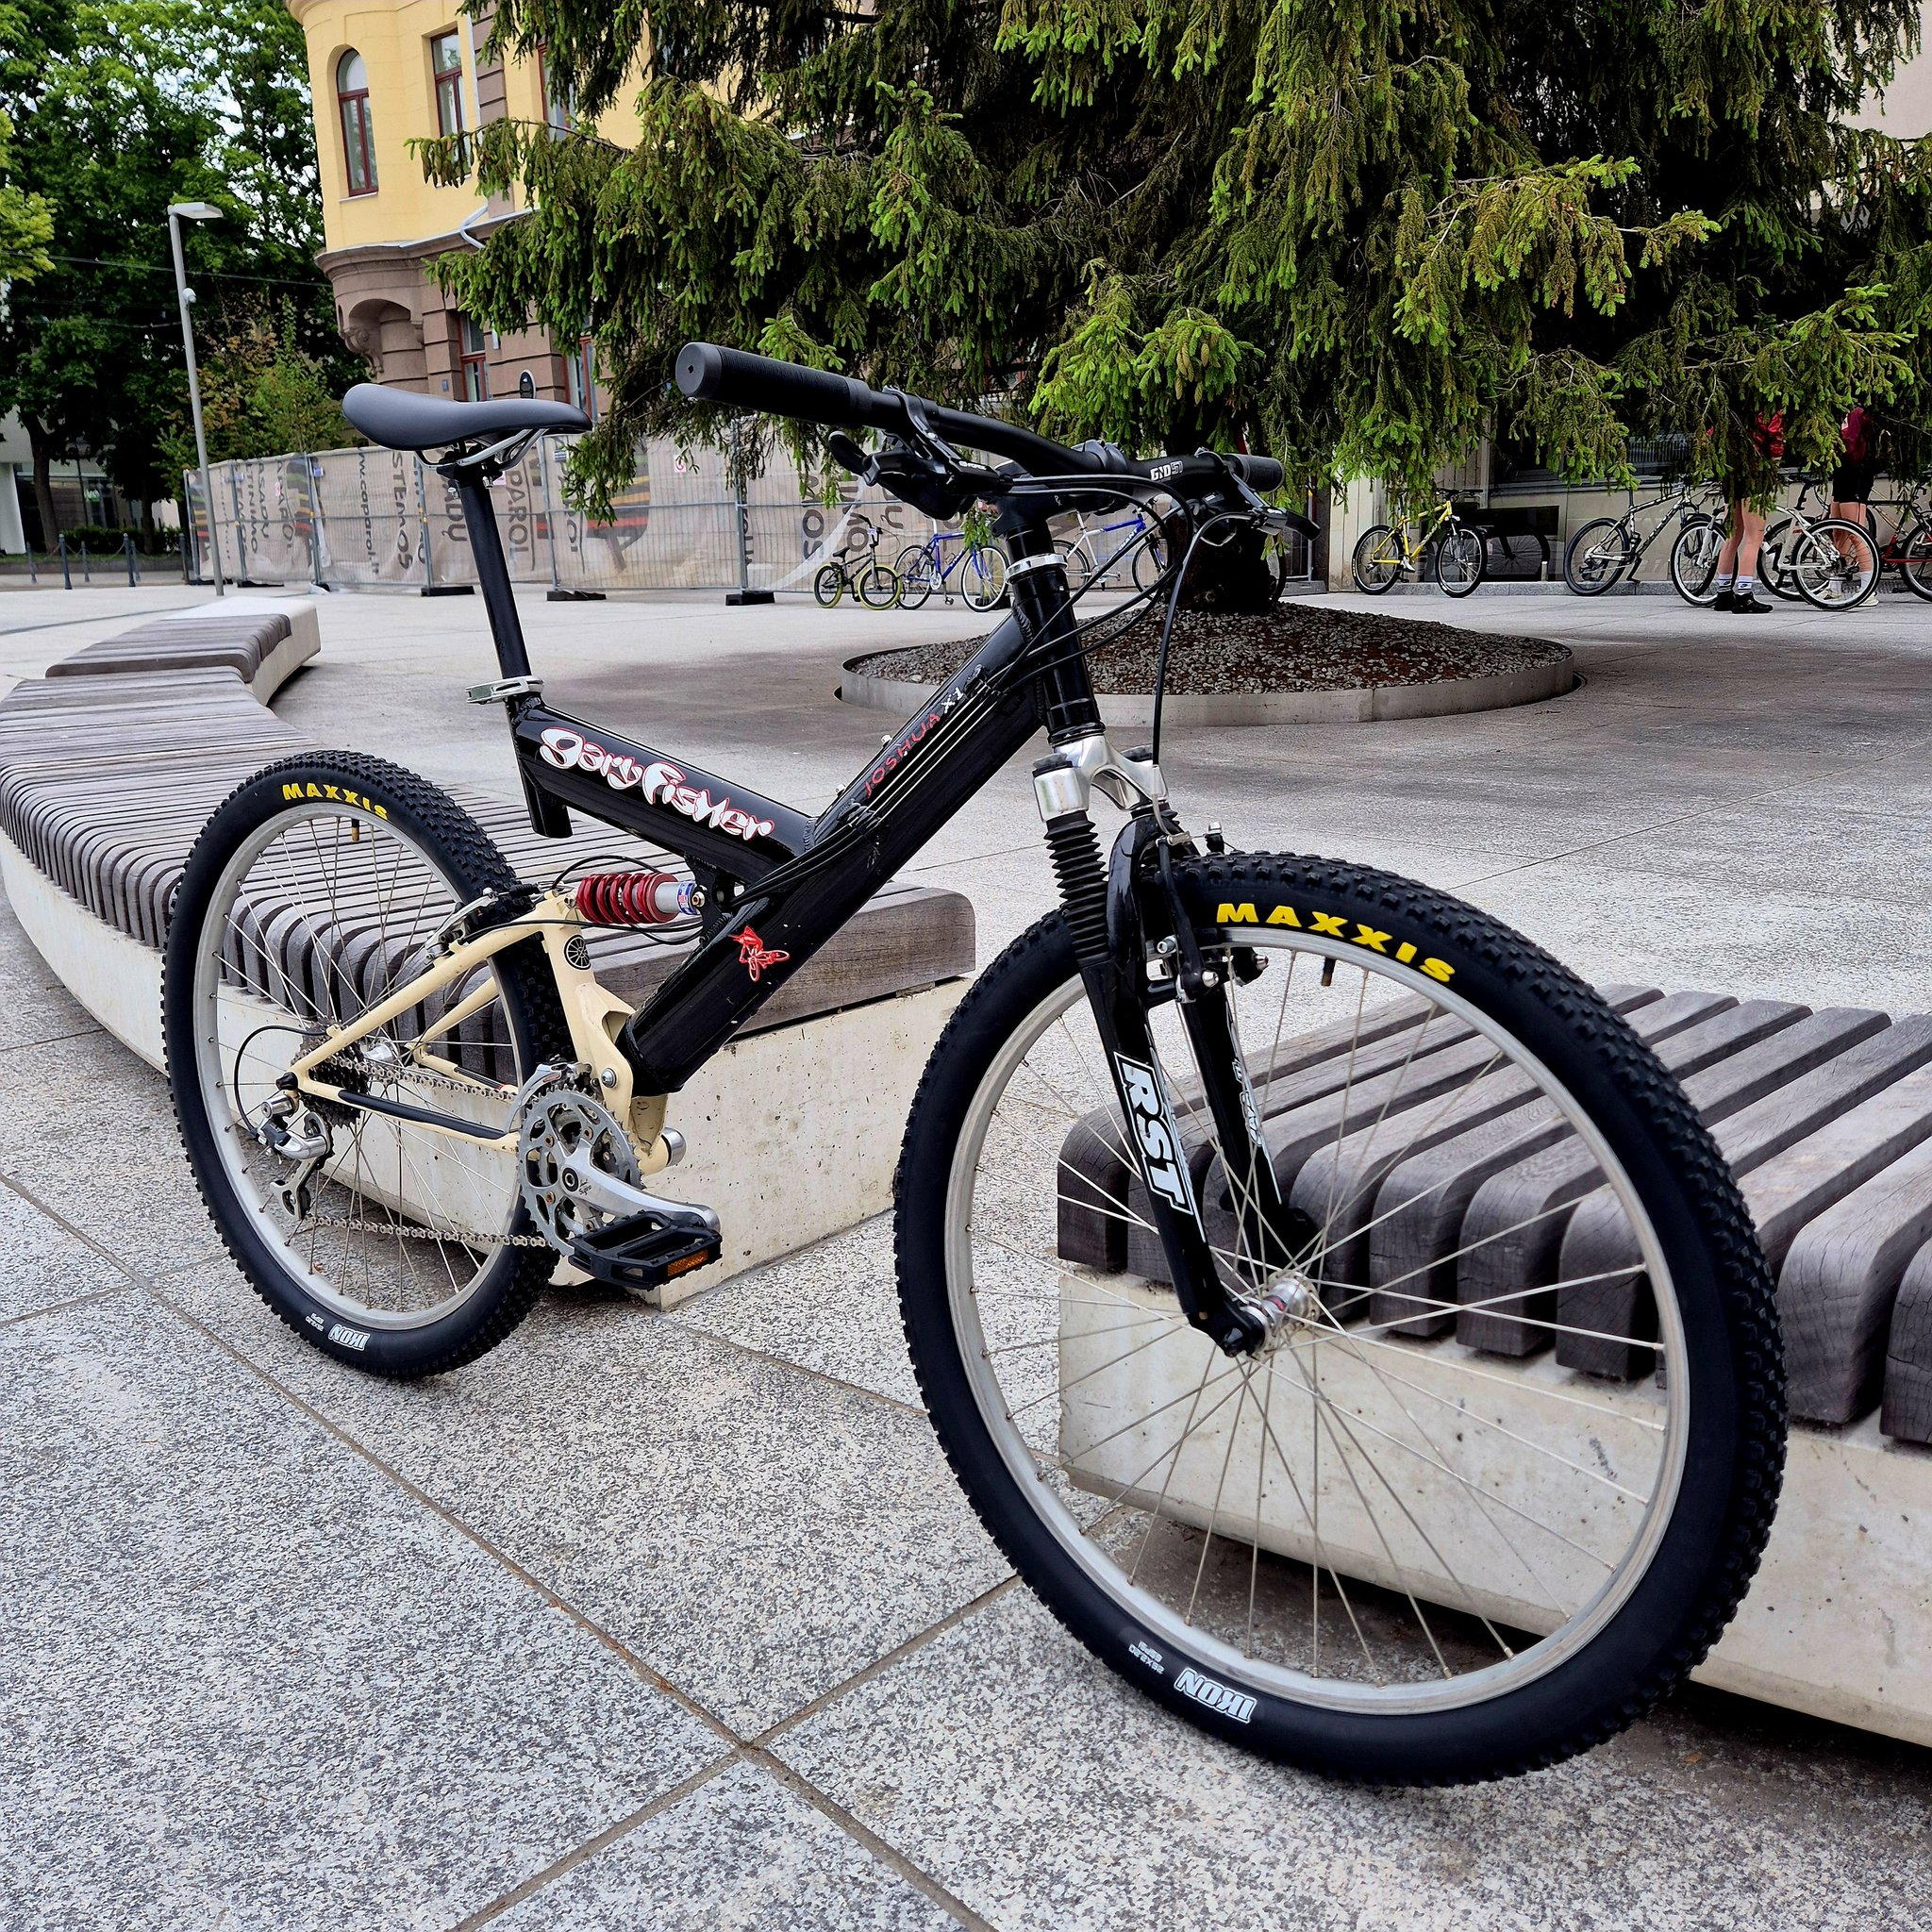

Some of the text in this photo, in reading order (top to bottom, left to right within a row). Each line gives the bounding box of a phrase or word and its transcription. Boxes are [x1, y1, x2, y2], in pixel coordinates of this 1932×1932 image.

[864, 712, 941, 798] JOSHUA
[282, 782, 390, 821] MAXXIS
[1216, 903, 1456, 983] MAXXIS
[1121, 1061, 1187, 1206] RST
[328, 1324, 371, 1351] IKON
[1174, 1667, 1257, 1723] IKON
